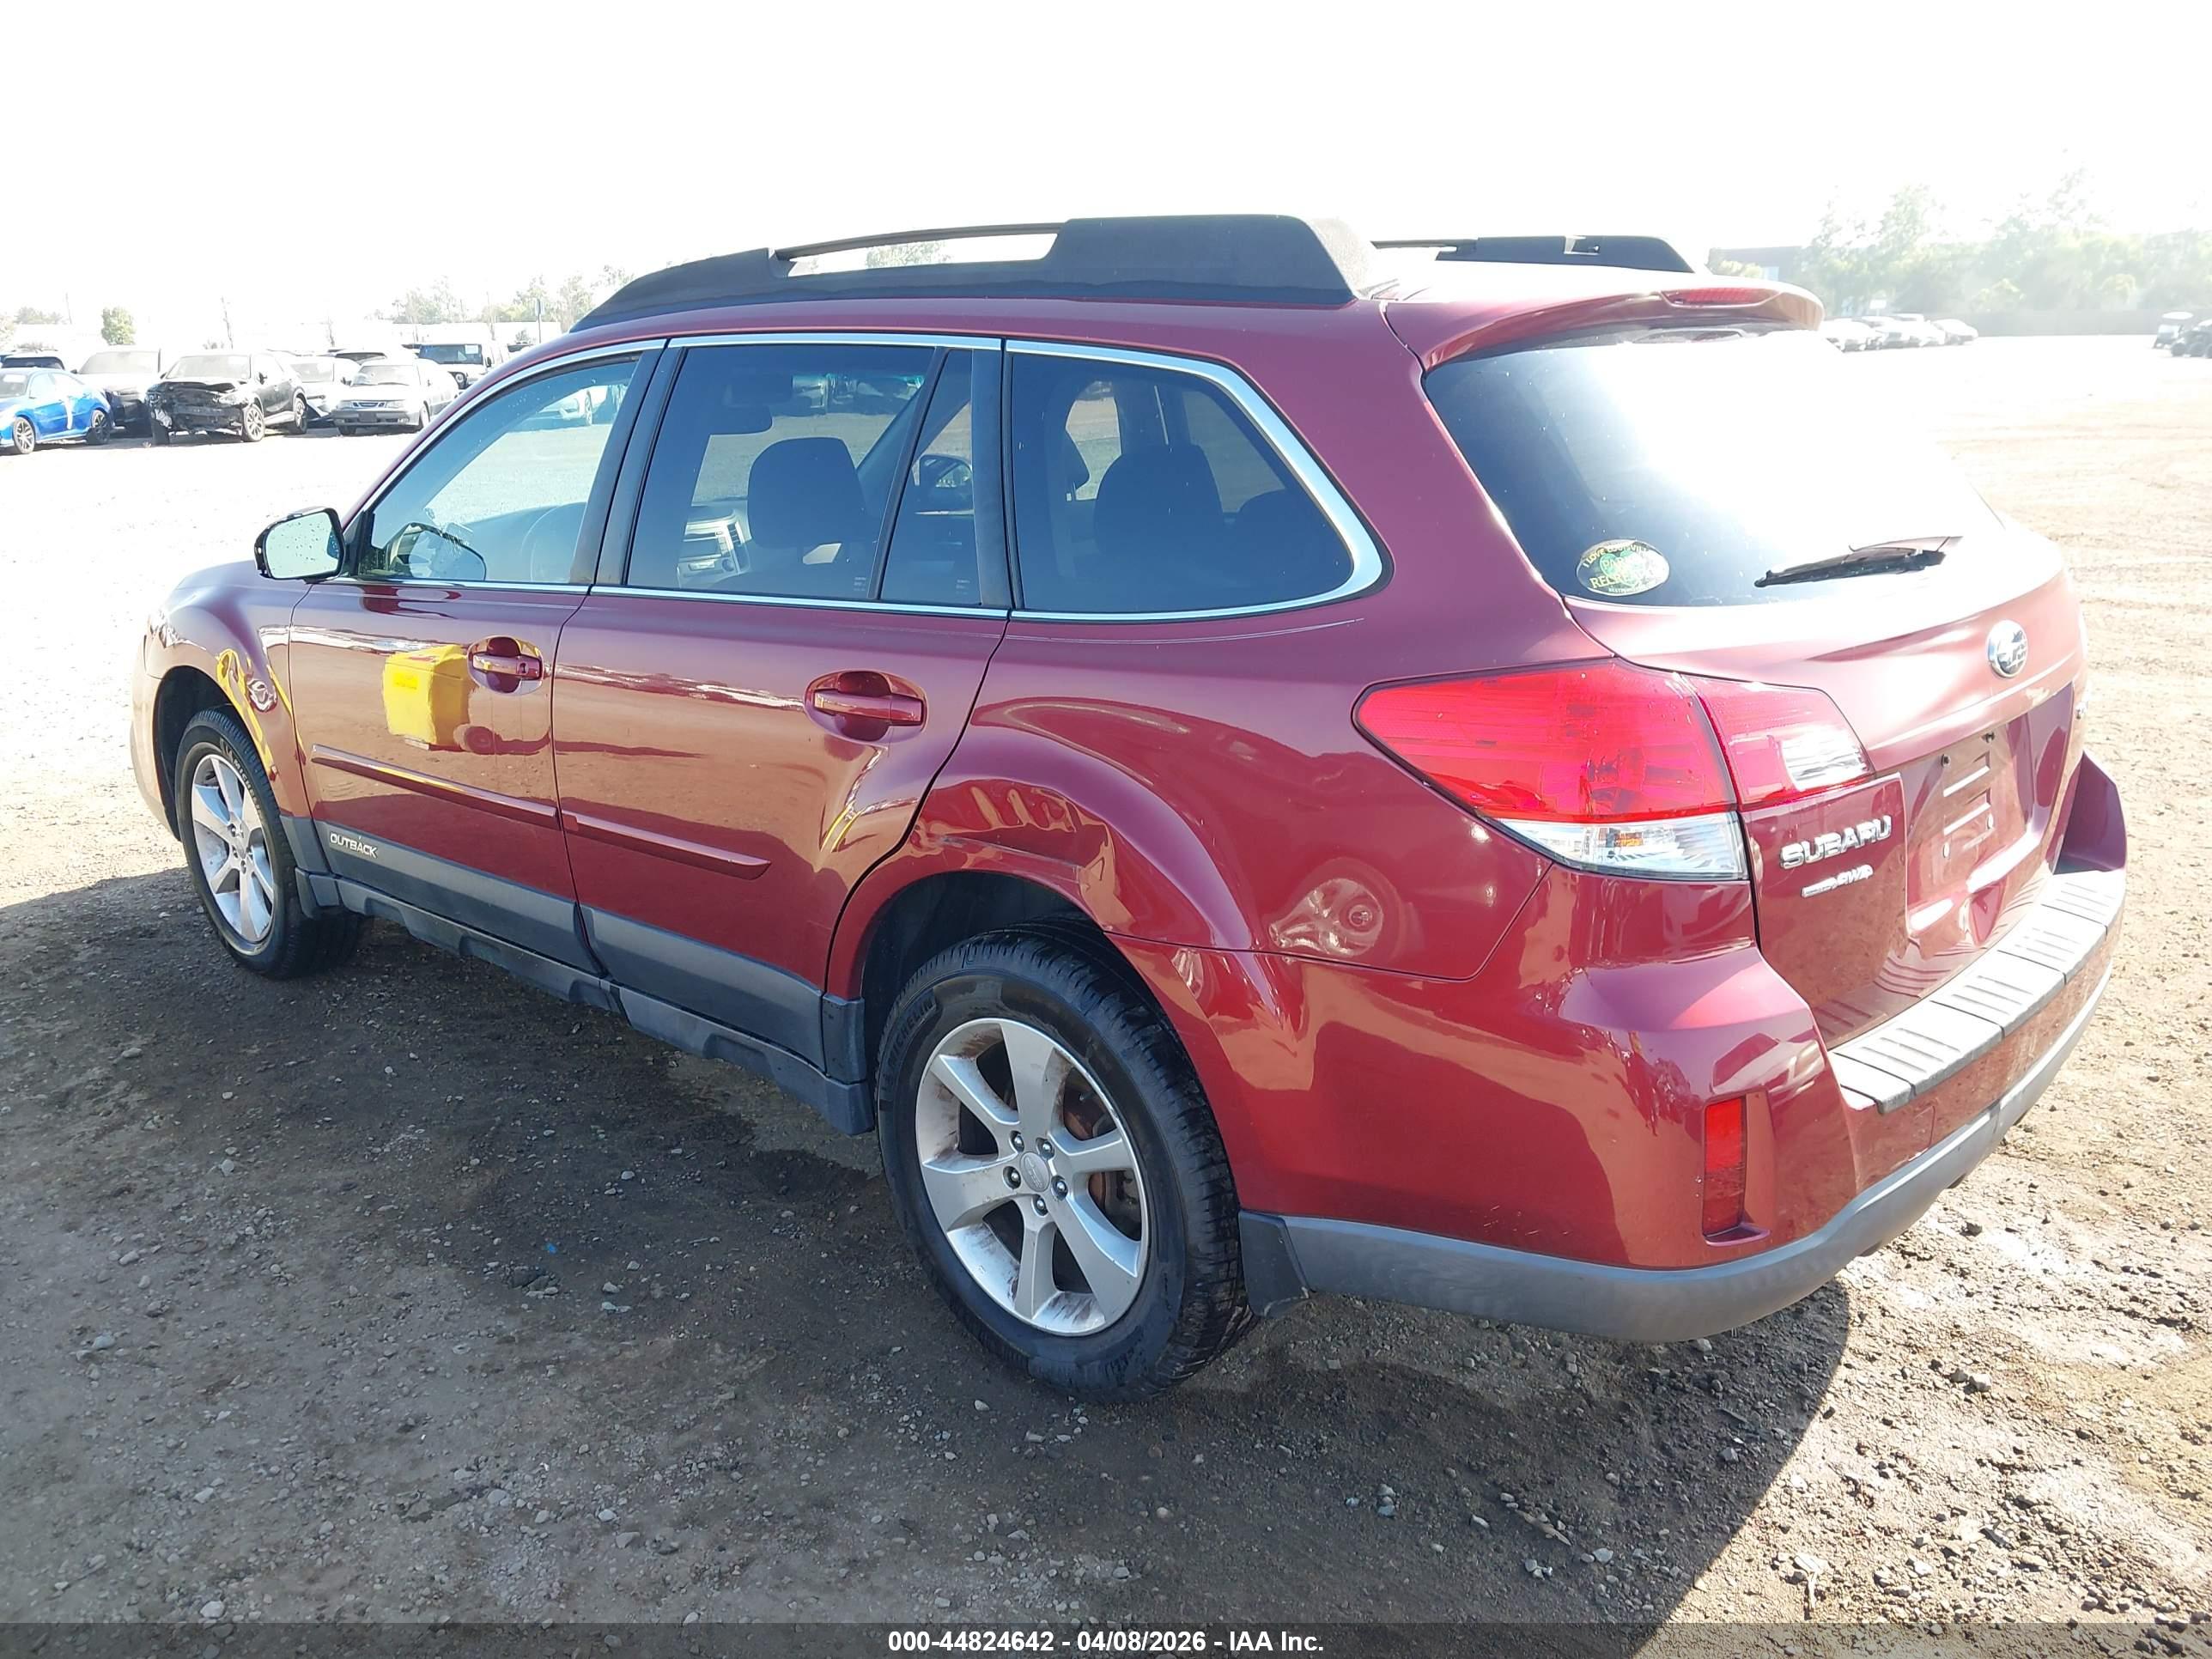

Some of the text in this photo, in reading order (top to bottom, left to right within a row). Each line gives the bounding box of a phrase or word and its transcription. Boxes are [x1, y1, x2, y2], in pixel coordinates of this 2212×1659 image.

[1586, 548, 1607, 564] LOVE
[330, 833, 377, 859] OUTBACK
[1779, 815, 1892, 869] SUBARU
[887, 997, 933, 1066] MICHELIN
